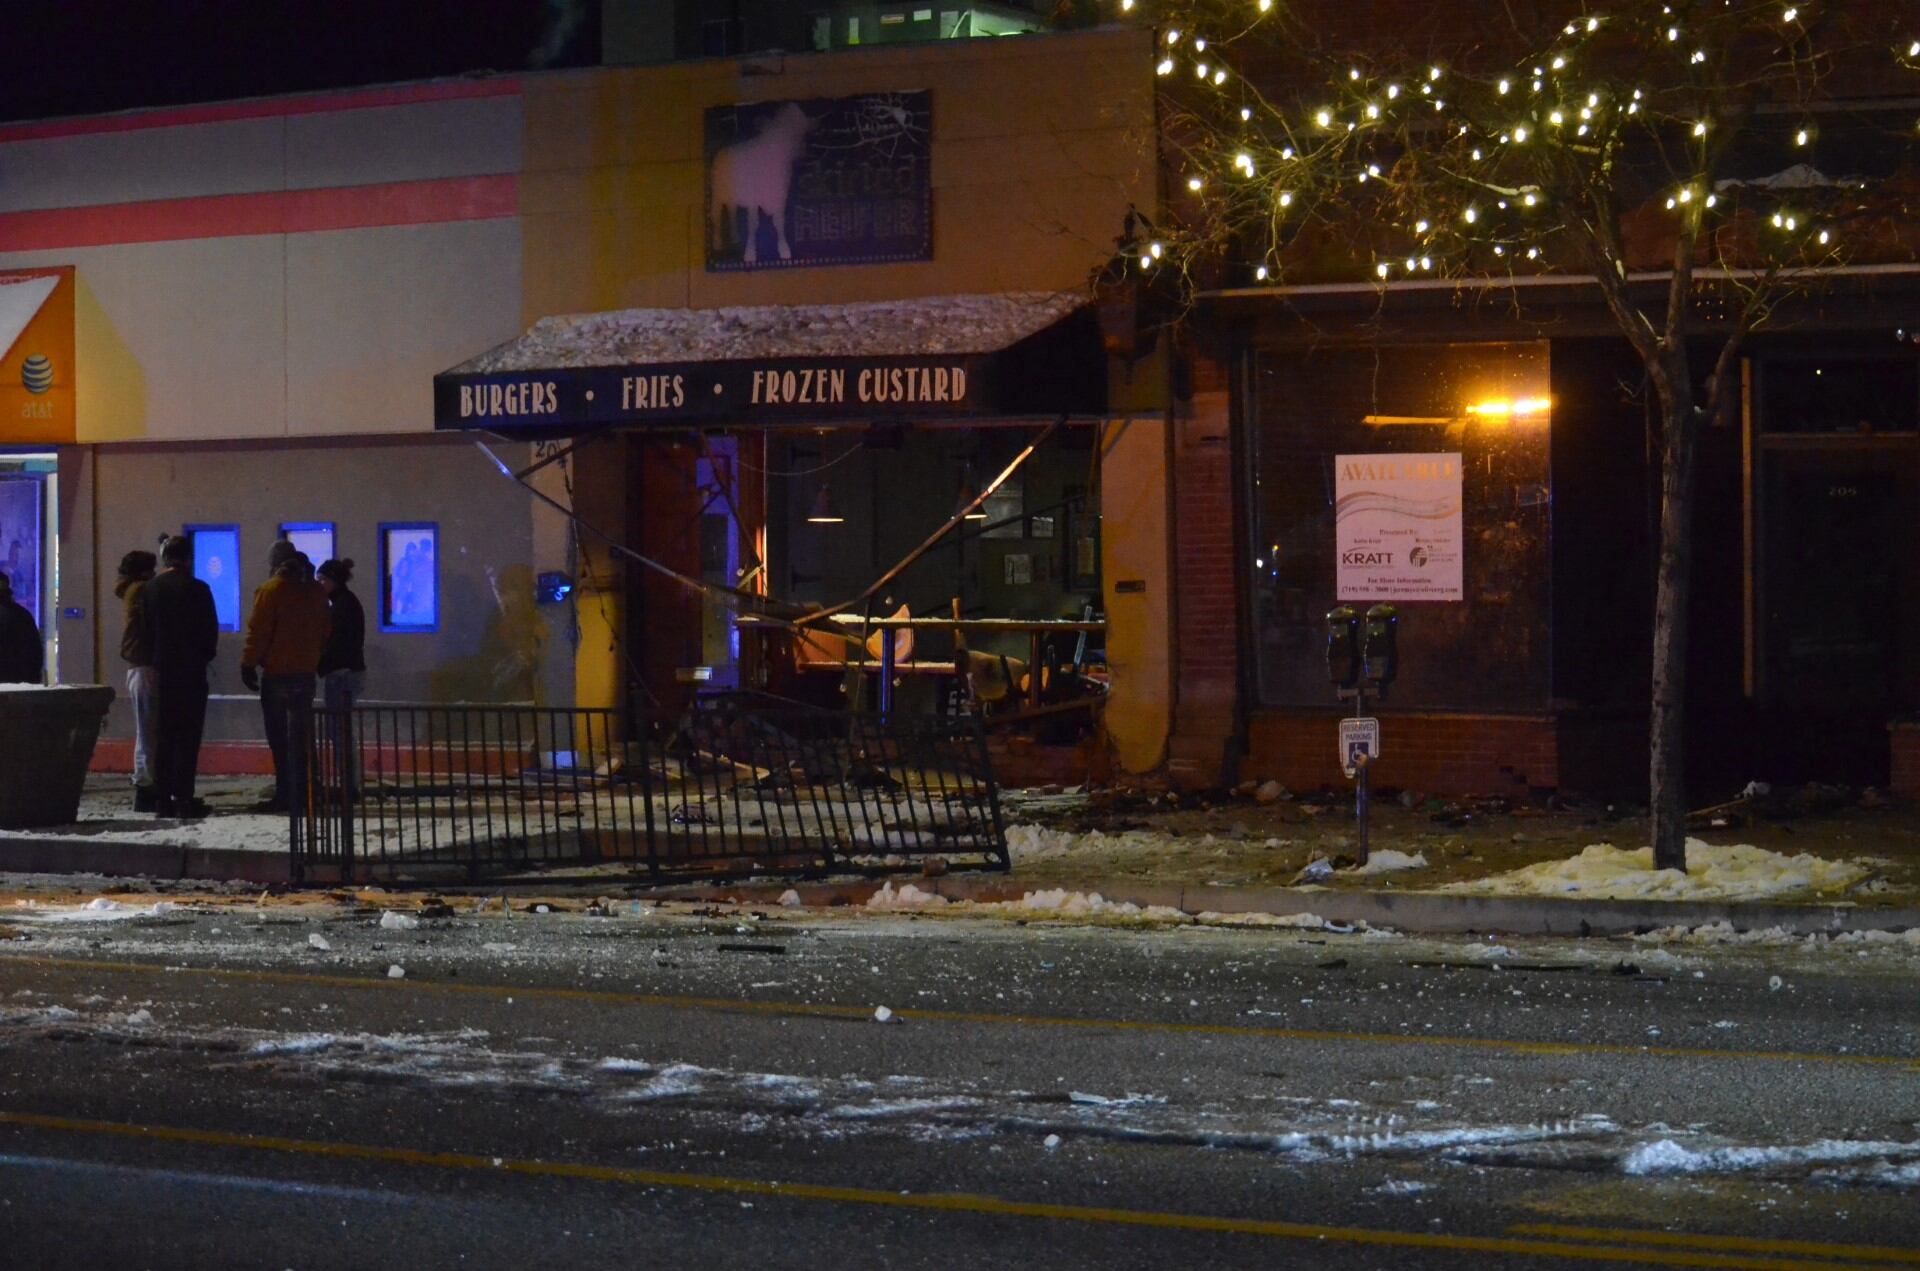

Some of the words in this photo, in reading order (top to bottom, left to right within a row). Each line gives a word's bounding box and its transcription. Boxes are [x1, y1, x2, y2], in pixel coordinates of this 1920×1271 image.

[460, 381, 558, 417] BURGERS
[621, 374, 685, 410] FRIES
[751, 368, 844, 404] FROZEN
[858, 367, 967, 403] CUSTARD
[1342, 463, 1455, 481] AVAIL
[1342, 552, 1394, 565] KRATT
